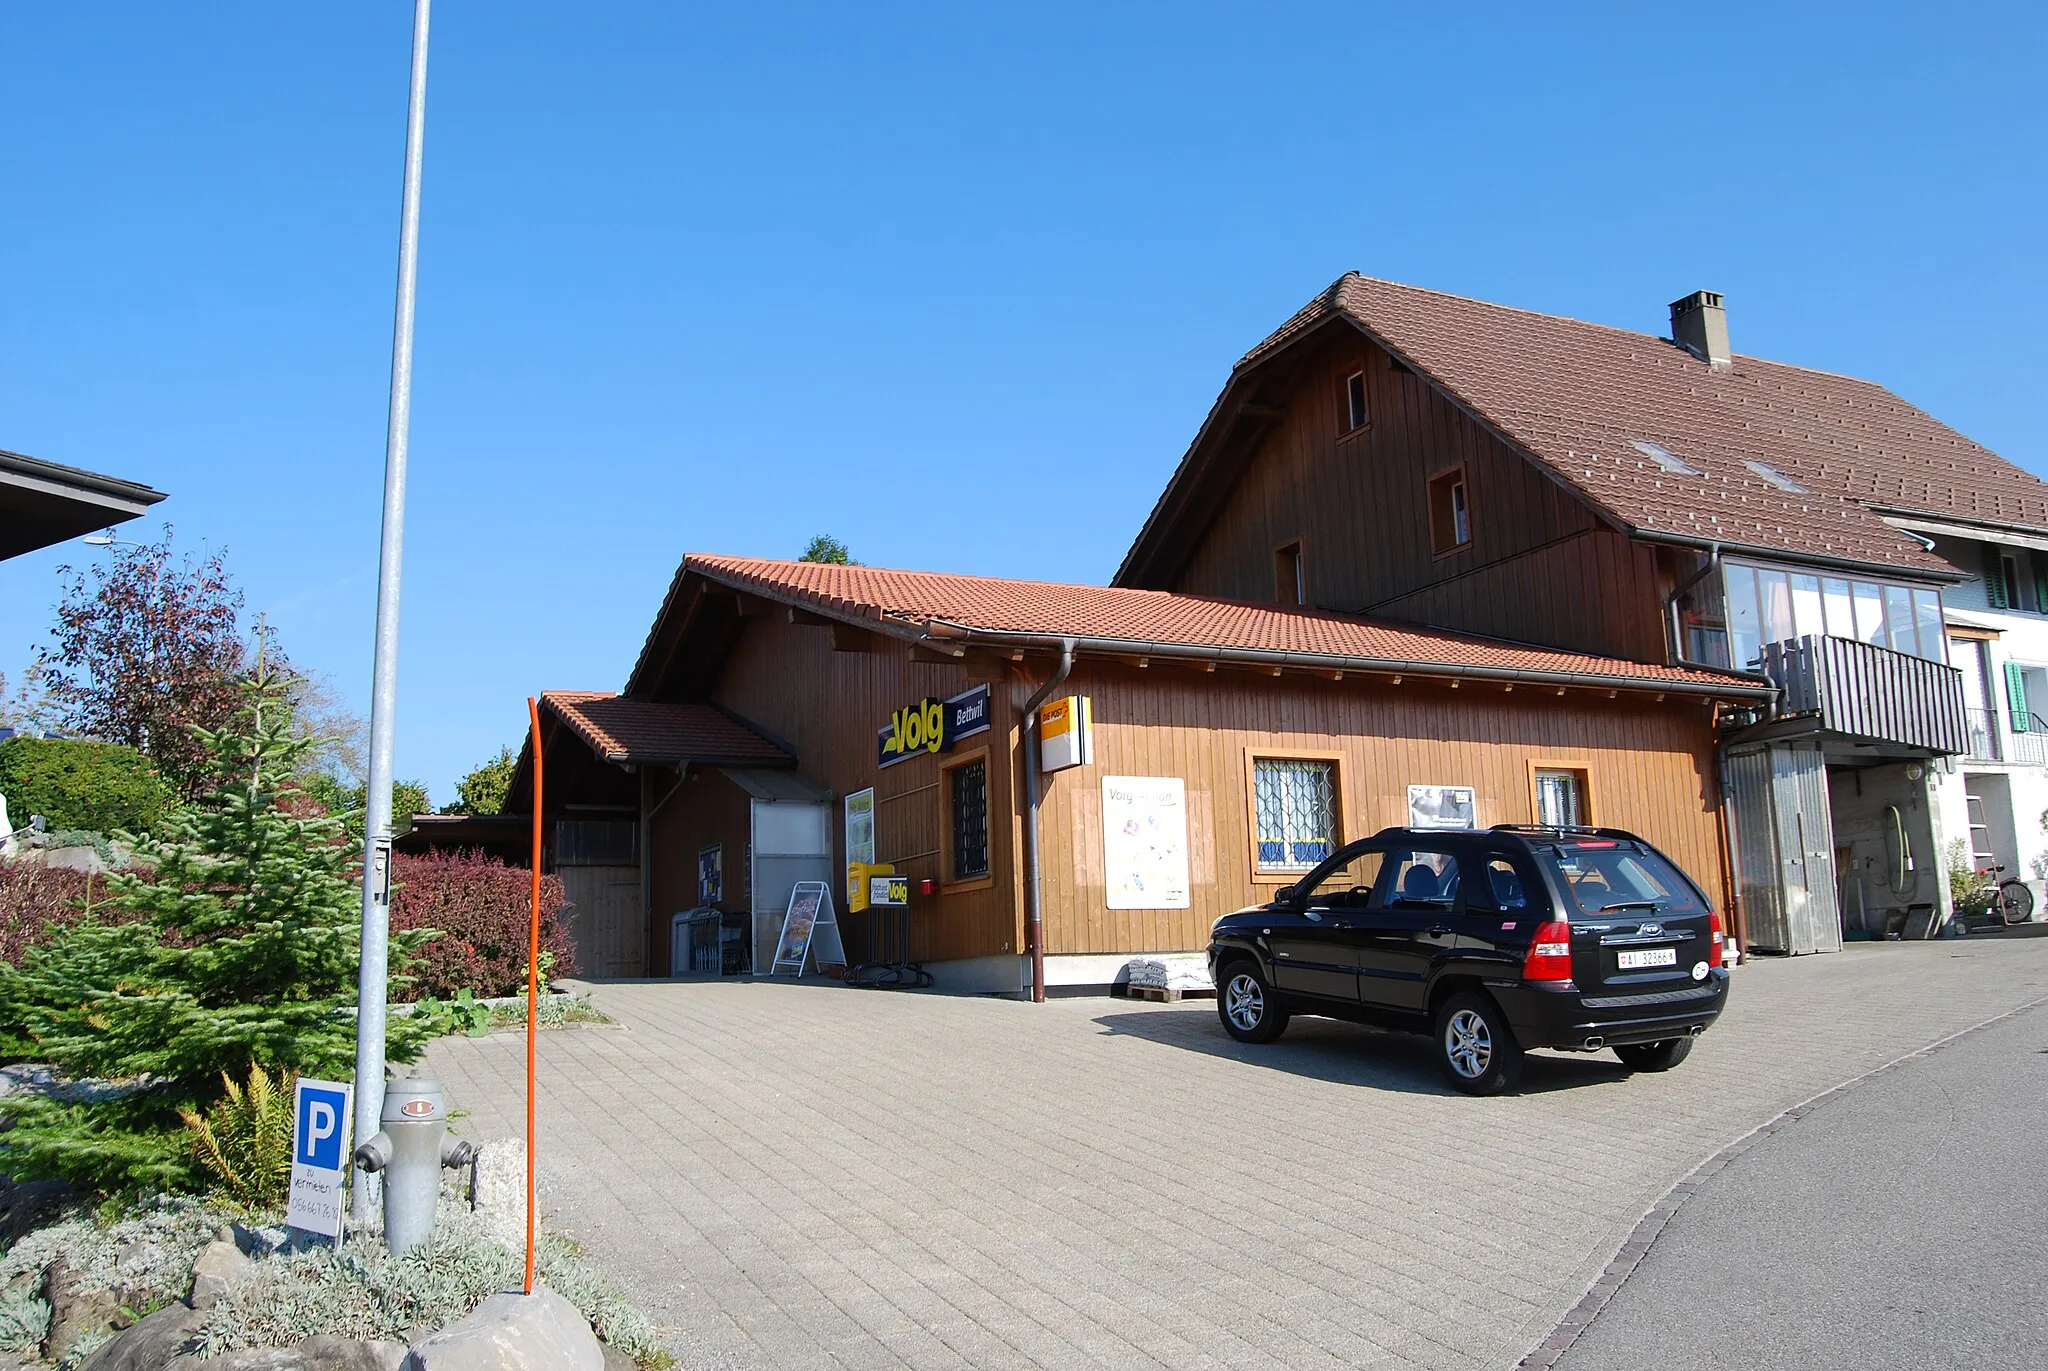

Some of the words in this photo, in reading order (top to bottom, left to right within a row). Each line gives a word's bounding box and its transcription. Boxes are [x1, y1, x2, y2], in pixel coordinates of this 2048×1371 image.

[892, 697, 944, 753] Volg
[956, 699, 983, 726] Bettwil
[1042, 711, 1051, 722] DIE
[1051, 707, 1063, 719] POST
[888, 881, 908, 904] Volg
[1695, 966, 1706, 977] CH
[307, 1100, 336, 1158] P
